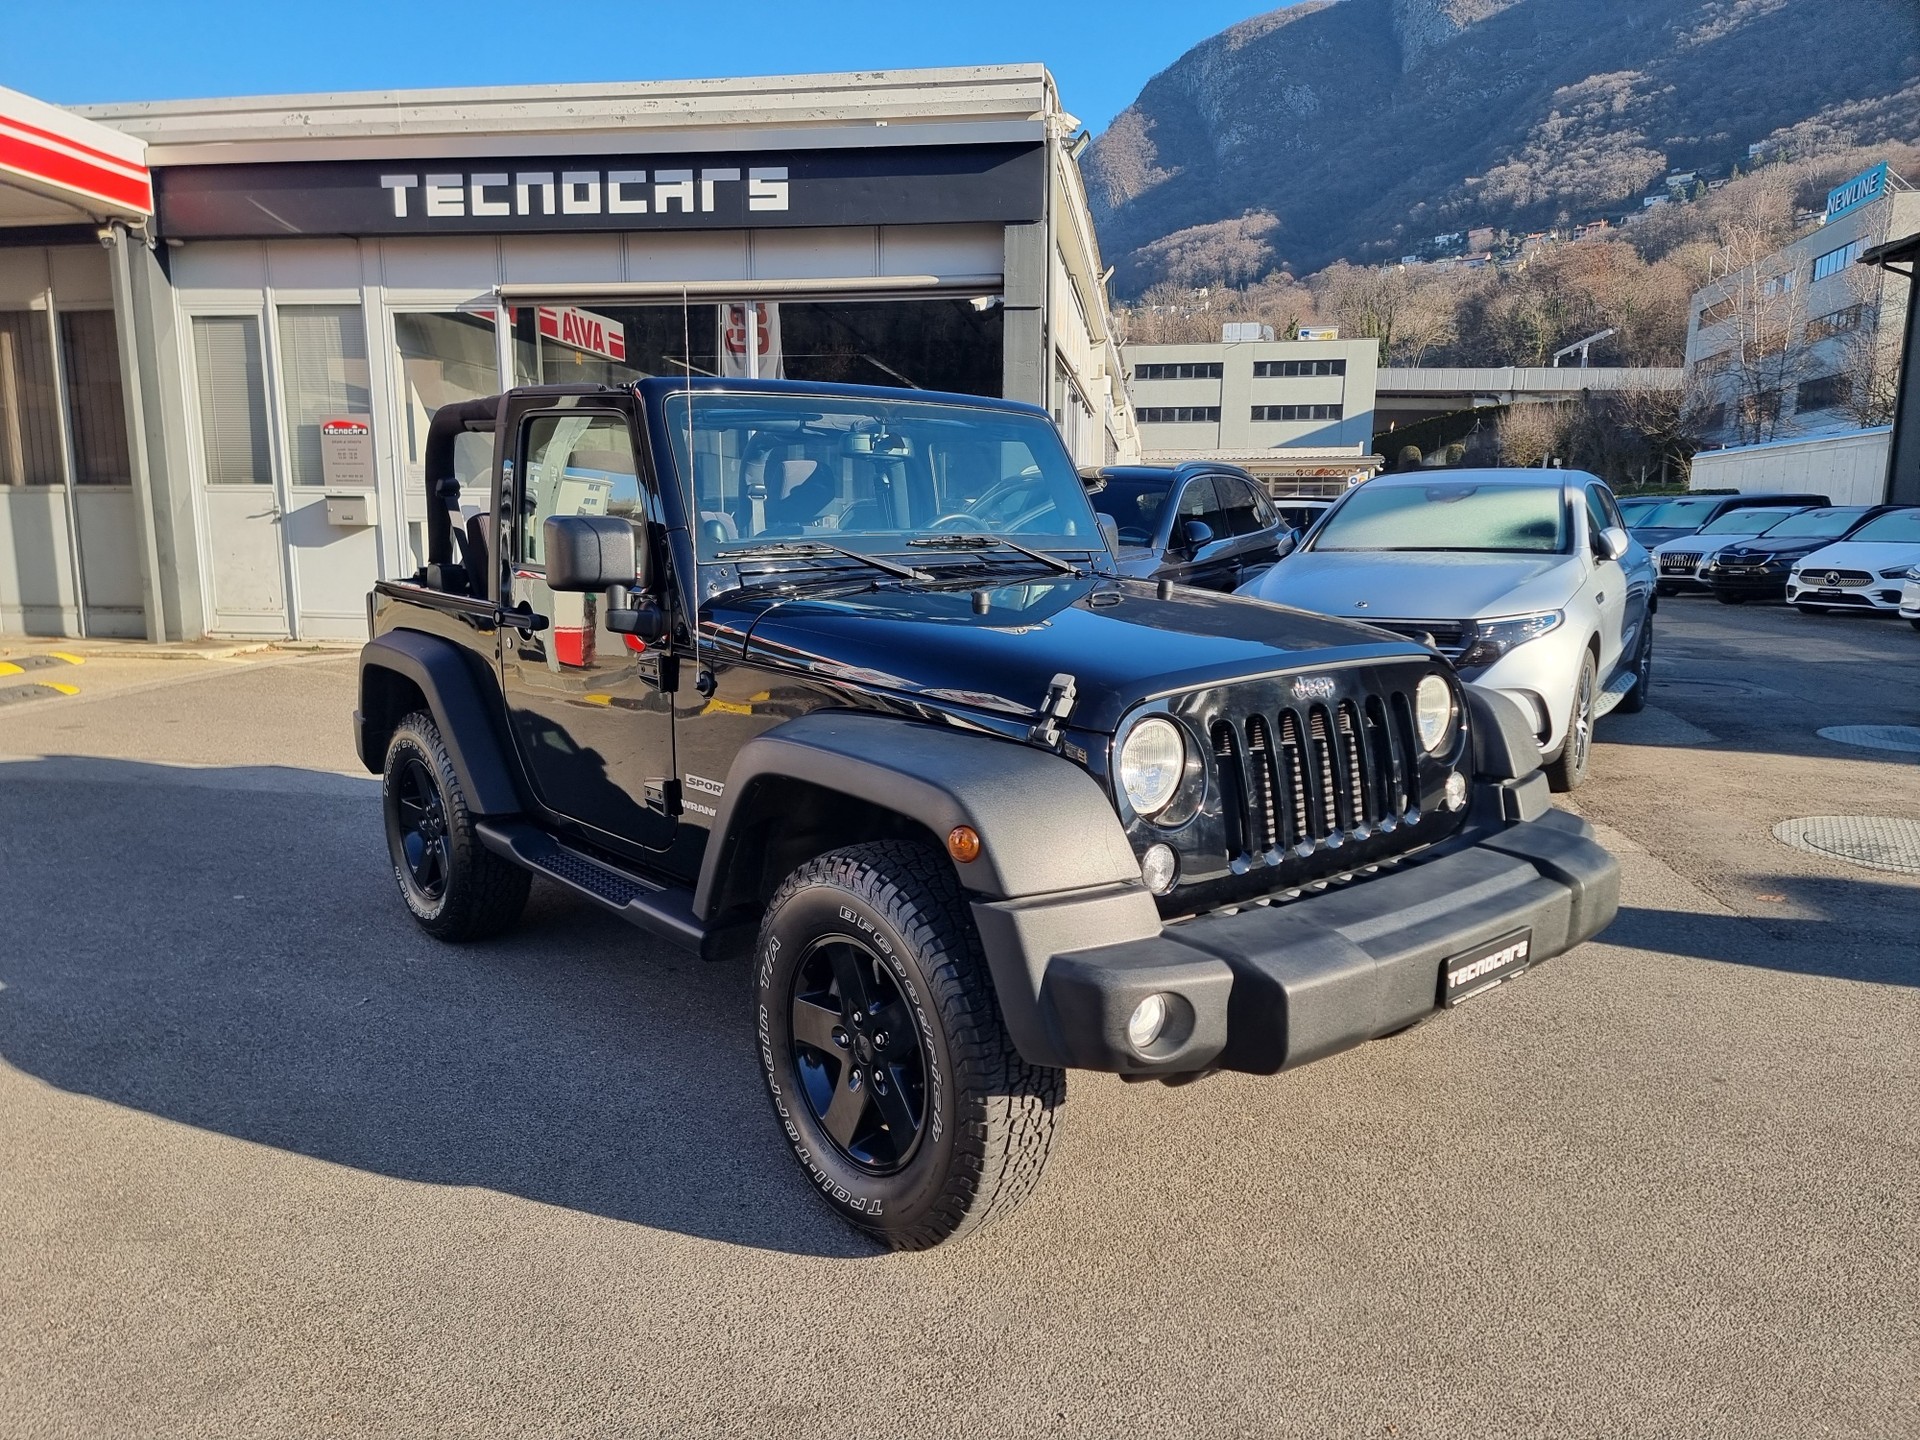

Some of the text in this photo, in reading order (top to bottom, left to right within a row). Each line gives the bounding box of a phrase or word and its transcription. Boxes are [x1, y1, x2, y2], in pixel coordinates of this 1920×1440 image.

[1827, 172, 1880, 215] NEWLINE
[1292, 676, 1335, 700] Jeep
[687, 777, 724, 793] SPOR
[839, 905, 945, 1144] BFGoodrich
